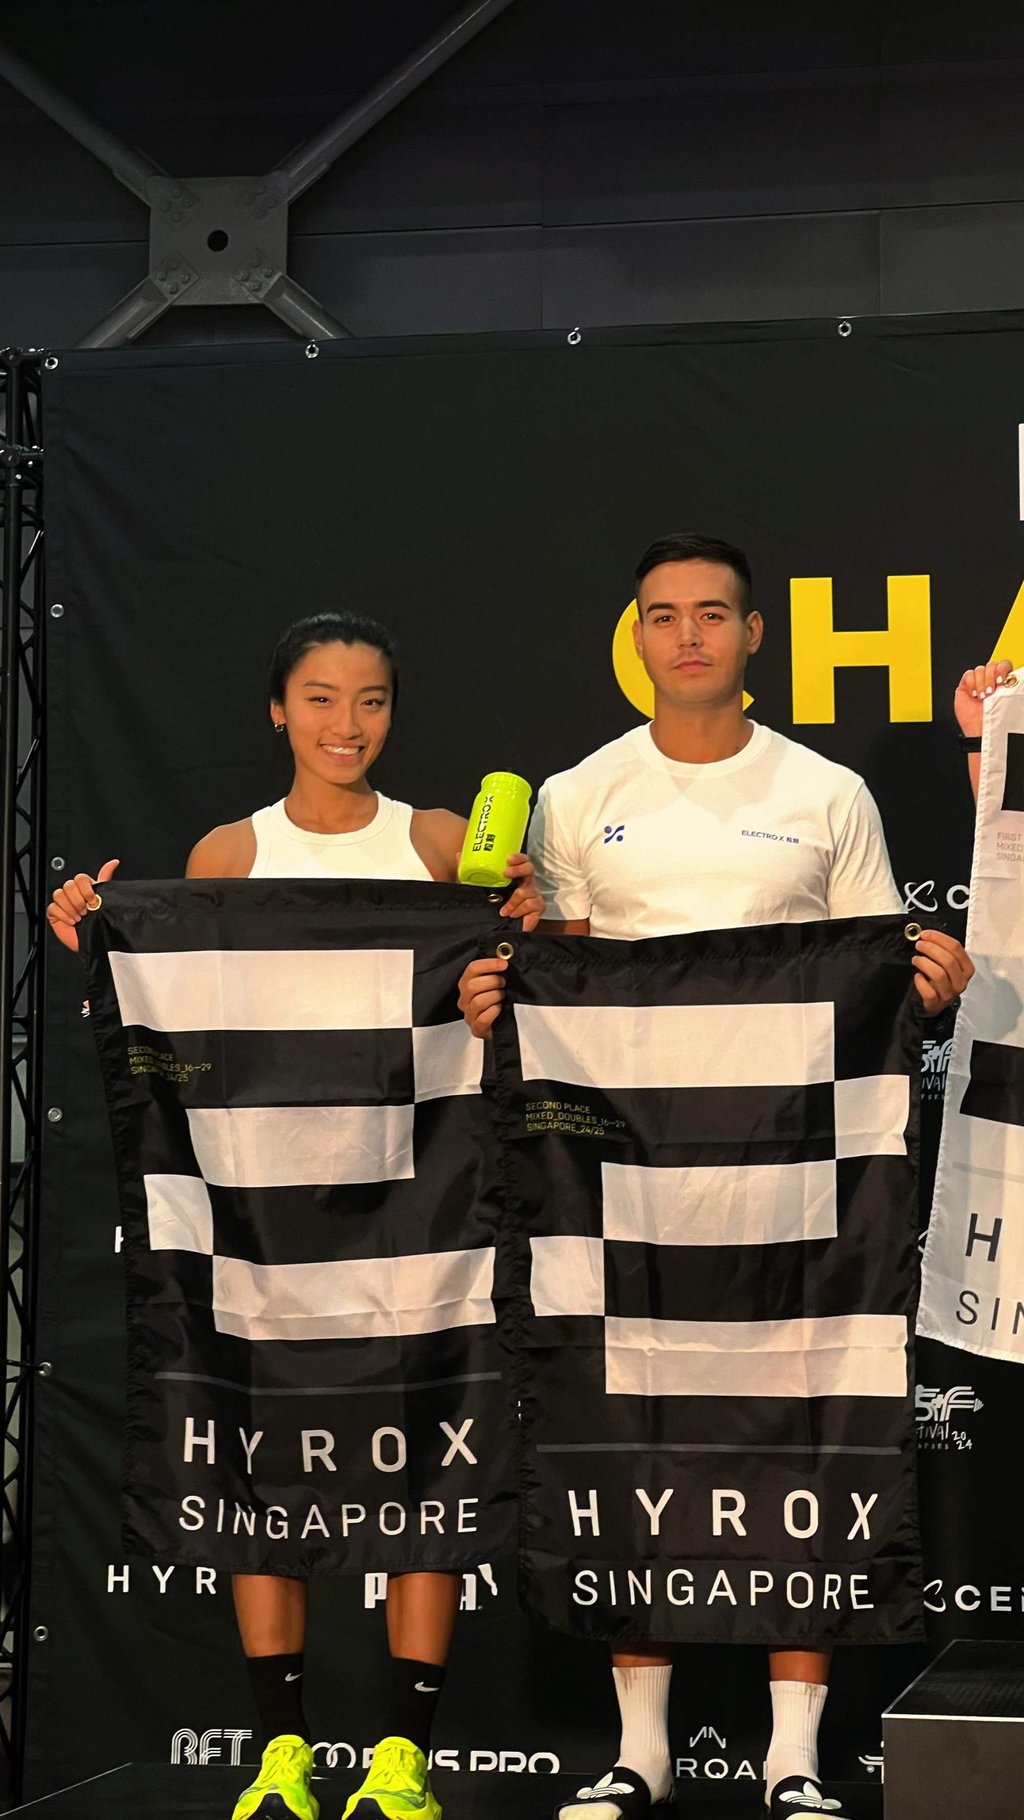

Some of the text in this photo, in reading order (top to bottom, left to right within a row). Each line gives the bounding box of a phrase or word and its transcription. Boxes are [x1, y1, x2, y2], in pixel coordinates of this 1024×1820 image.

[472, 804, 491, 852] ELECTRO
[741, 829, 778, 841] ELECTRO
[525, 1101, 591, 1114] SECOND PLACE
[183, 1416, 478, 1475] HYROX
[178, 1495, 479, 1540] SINGAPORE
[567, 1488, 879, 1541] HYROX
[572, 1568, 875, 1610] SINGAPORE
[955, 1584, 1024, 1612] CE
